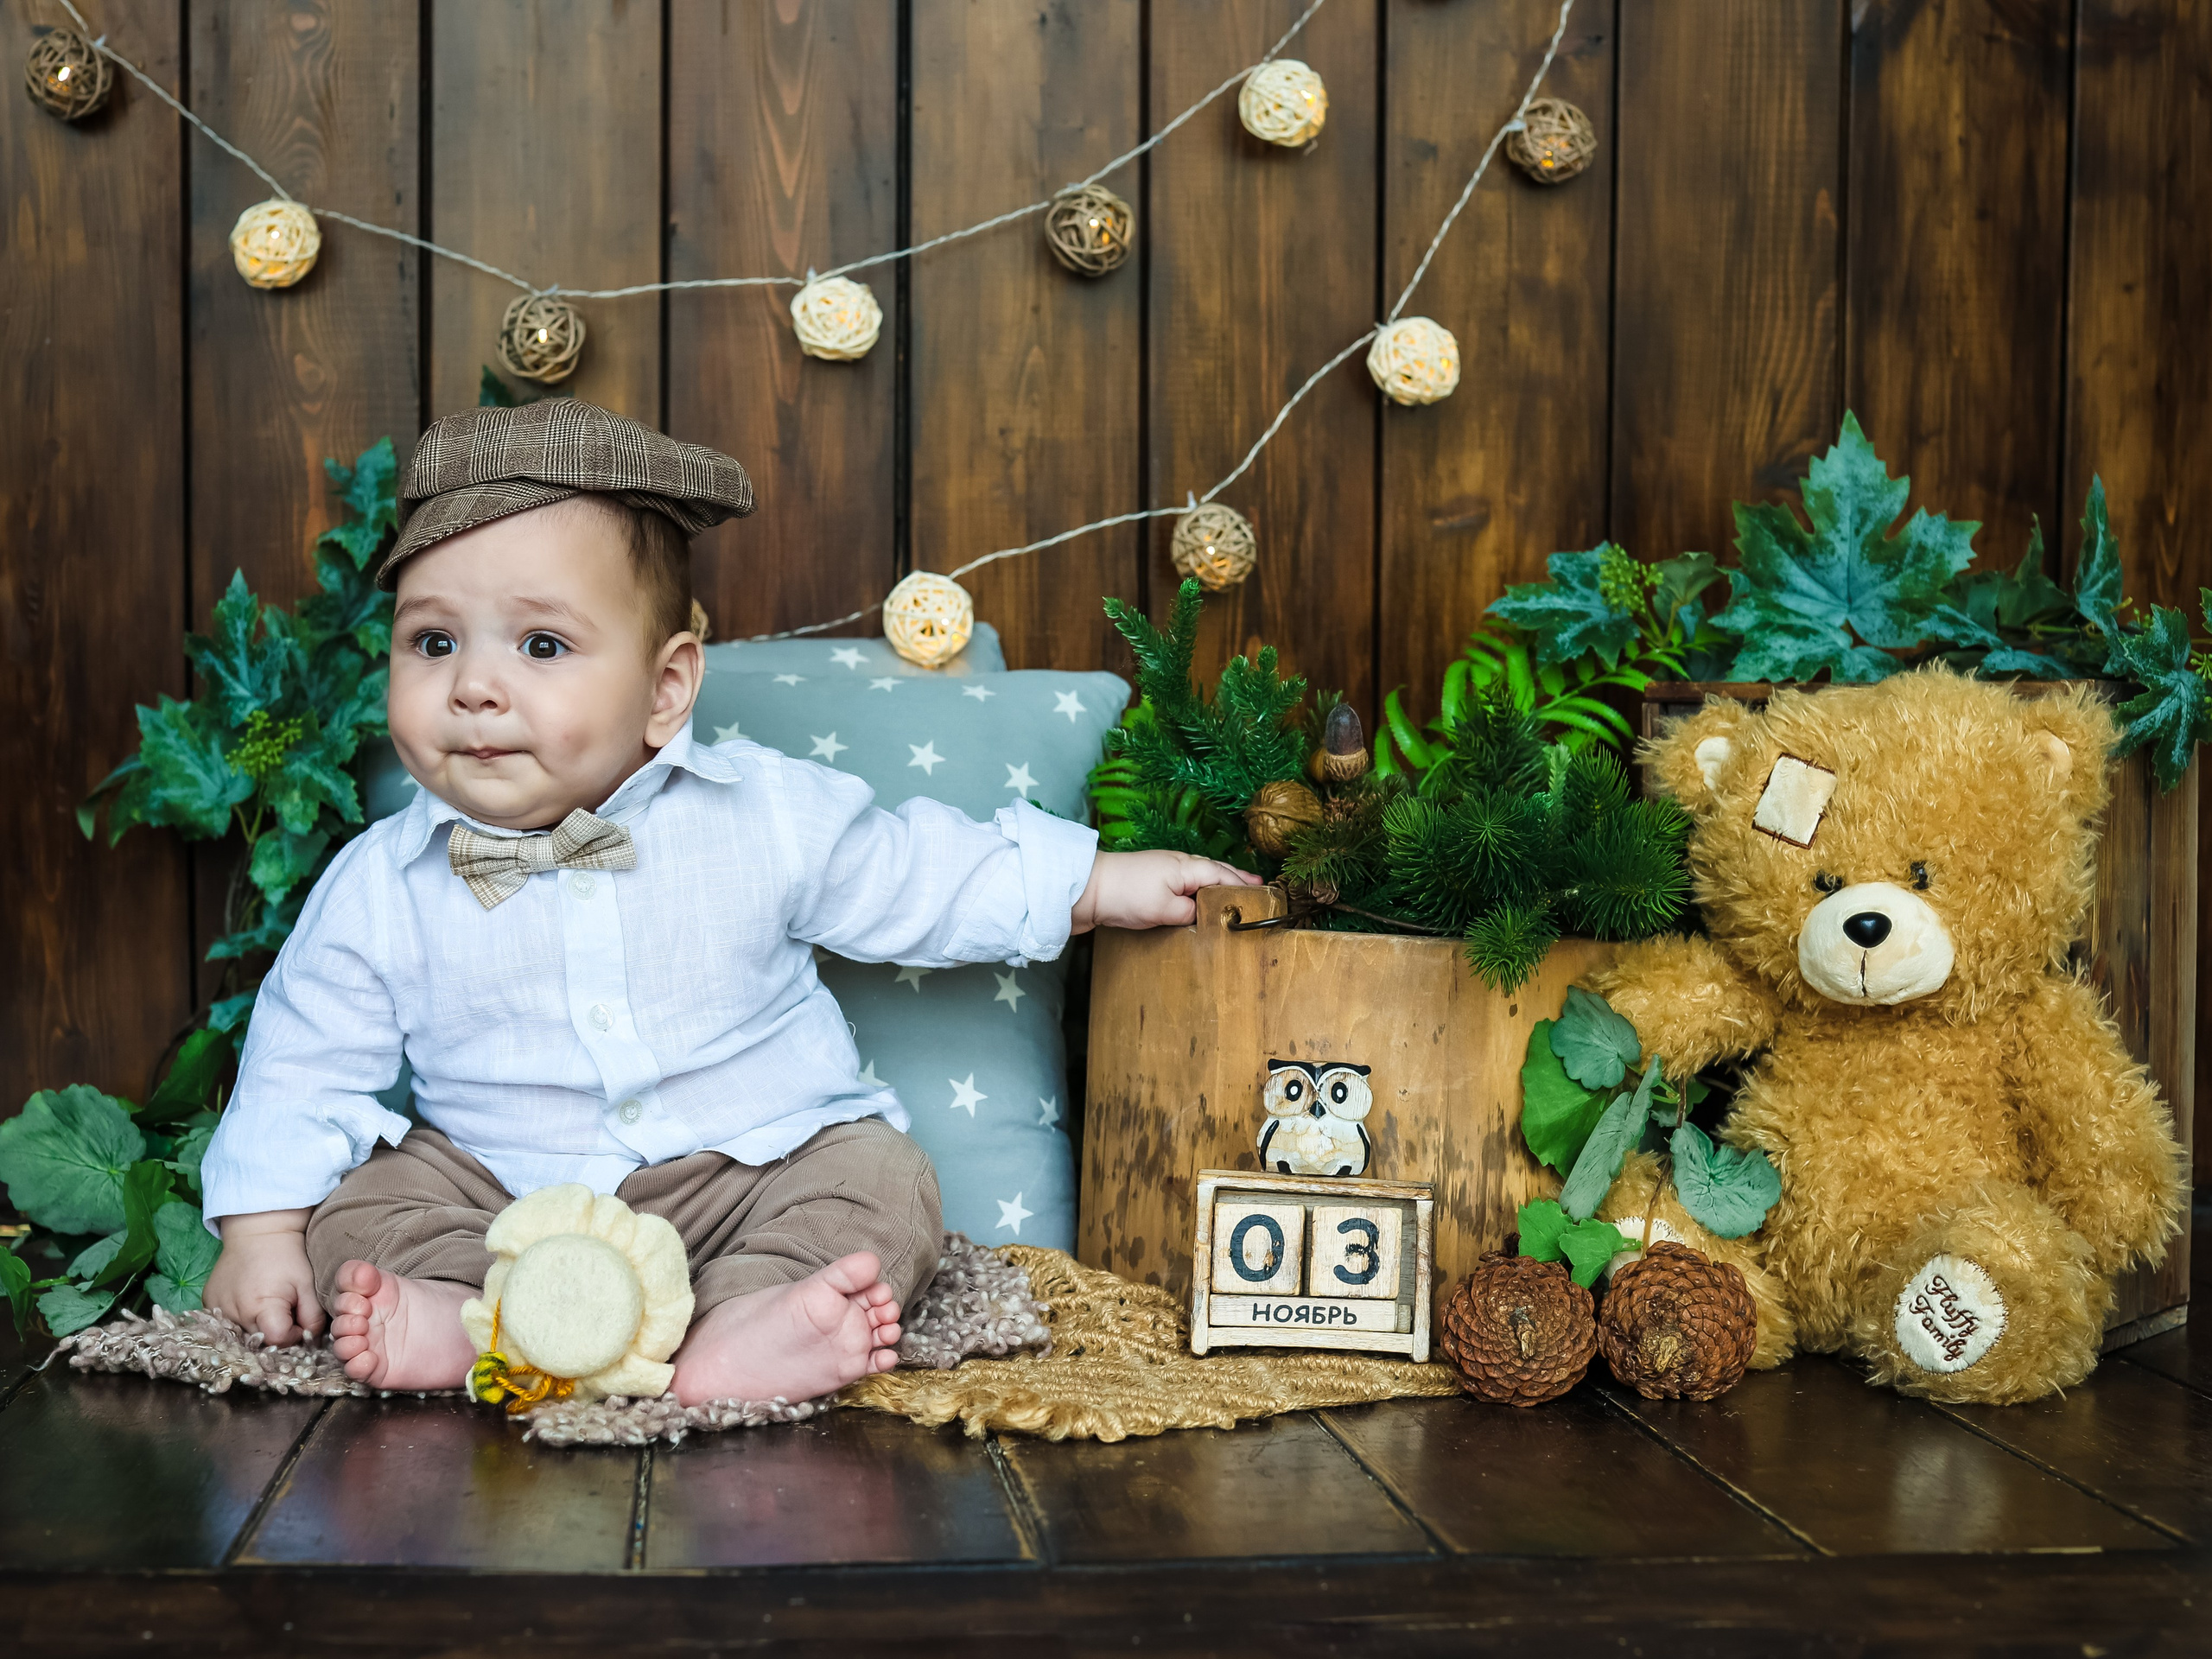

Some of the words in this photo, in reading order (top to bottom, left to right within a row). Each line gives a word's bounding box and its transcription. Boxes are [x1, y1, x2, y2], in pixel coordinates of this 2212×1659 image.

[1252, 1302, 1357, 1325] НОЯБРЬ
[1910, 1294, 1967, 1362] Family
[1925, 1275, 1980, 1338] Fluffy
